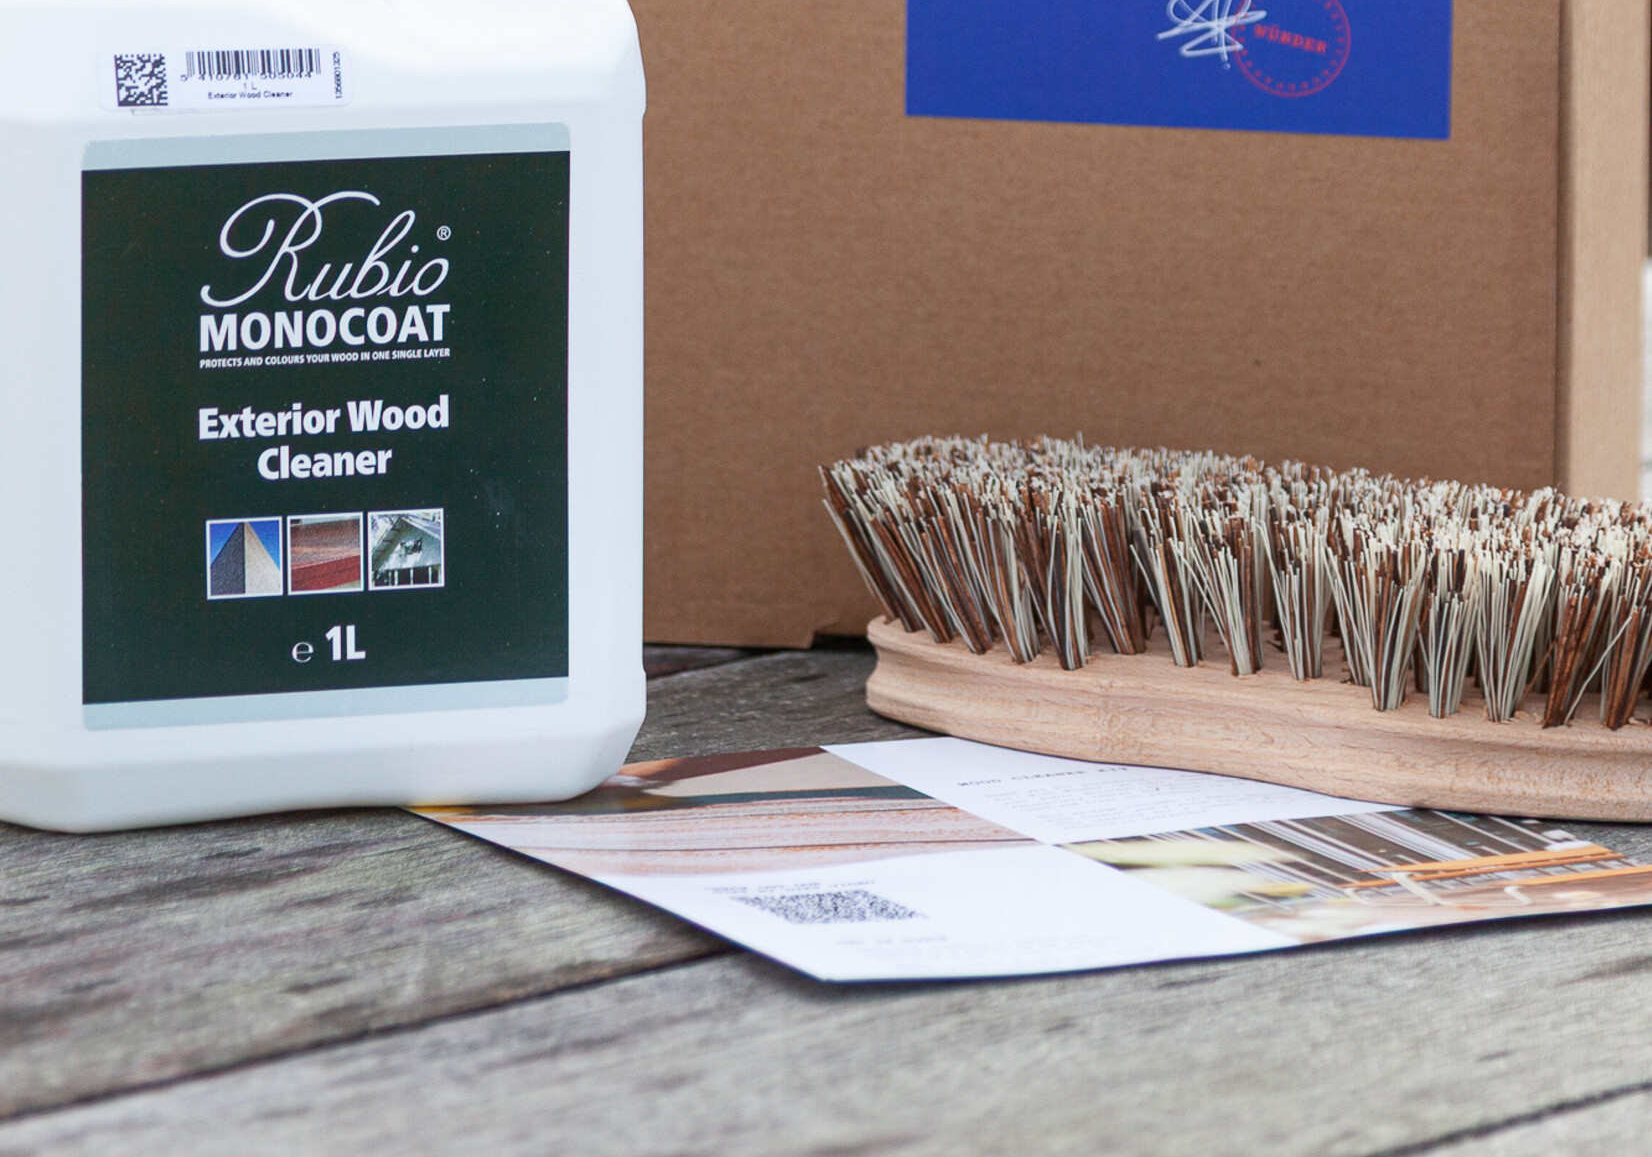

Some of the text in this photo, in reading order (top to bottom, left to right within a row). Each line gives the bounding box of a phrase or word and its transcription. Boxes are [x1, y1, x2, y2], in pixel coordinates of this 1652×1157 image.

[208, 90, 294, 100] Exterior Wood Cleaner
[200, 190, 450, 308] Rubio
[199, 303, 451, 353] MONOCOAT
[199, 347, 451, 369] PROTECTS AND COLOURS YOUR WOOD IN ONE SINGLE LAYER
[198, 394, 450, 440] Exterior Wood
[257, 444, 393, 481] Cleaner
[325, 624, 367, 662] 1L
